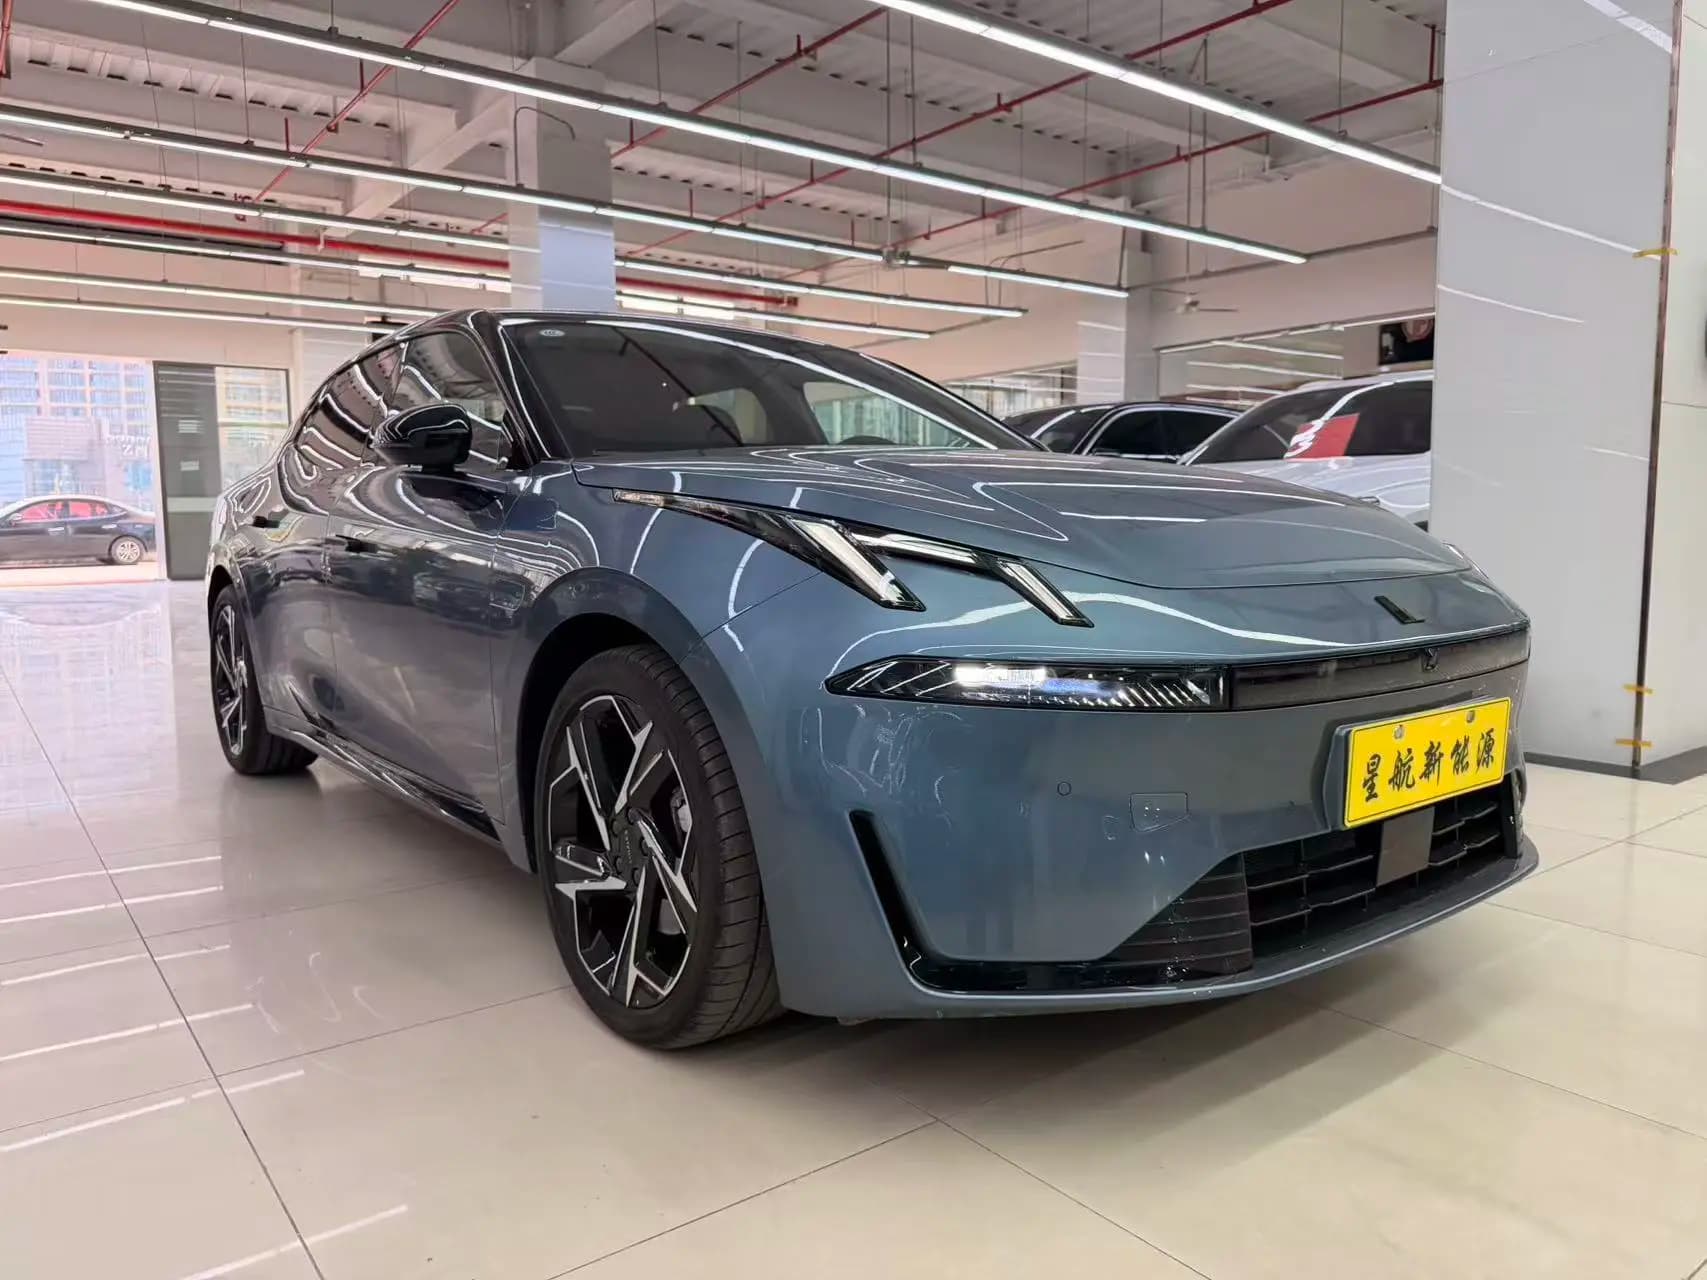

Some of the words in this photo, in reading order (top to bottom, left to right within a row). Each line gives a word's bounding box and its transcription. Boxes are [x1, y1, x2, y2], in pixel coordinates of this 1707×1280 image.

[1362, 727, 1495, 802] 星航新能源
